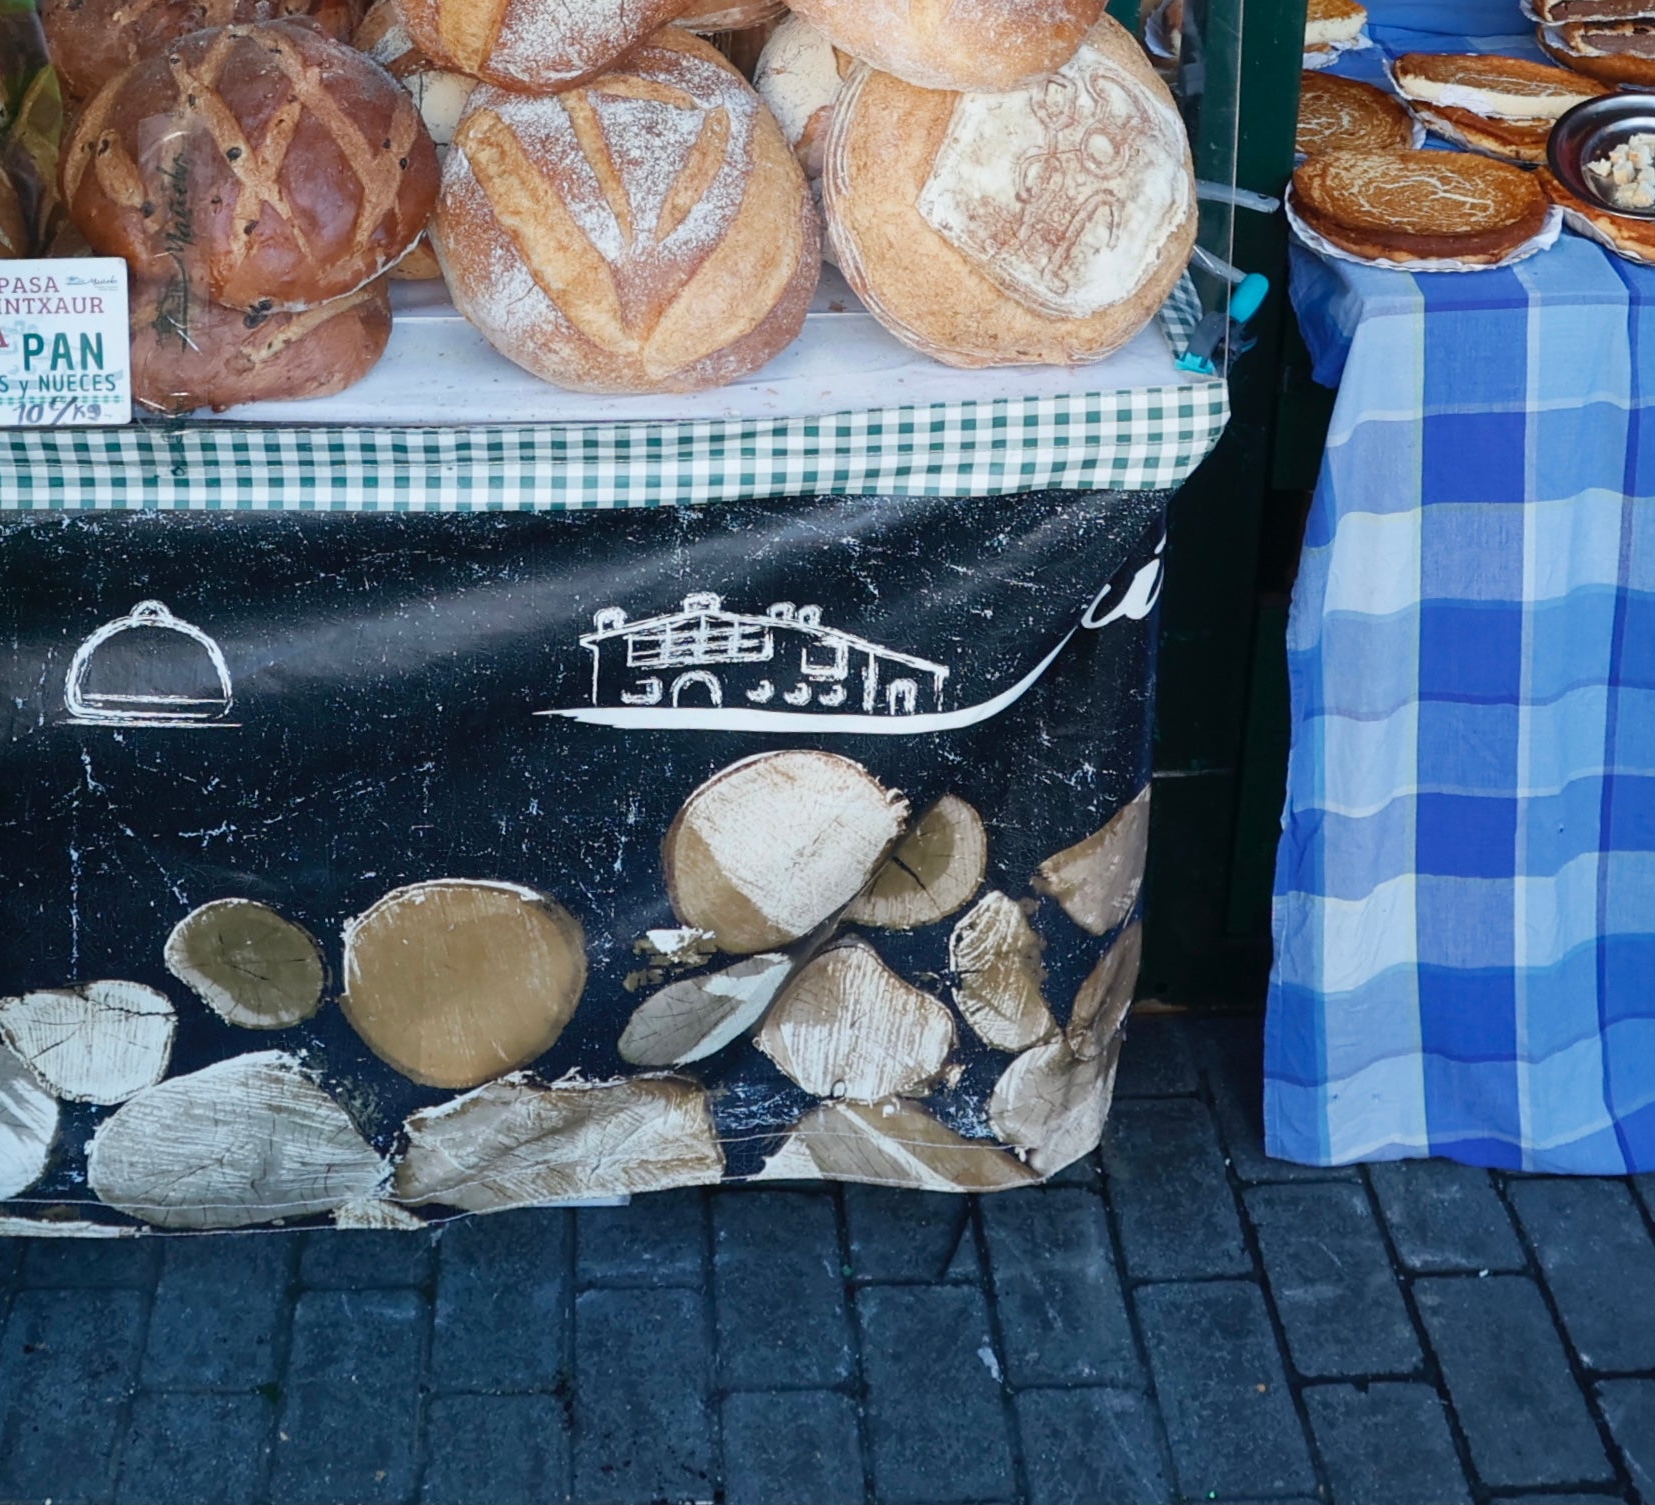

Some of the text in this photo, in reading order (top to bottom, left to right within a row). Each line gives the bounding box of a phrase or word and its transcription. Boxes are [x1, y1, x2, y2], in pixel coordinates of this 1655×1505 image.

[23, 332, 104, 371] PAN
[19, 380, 30, 396] y
[39, 374, 116, 392] NUECES
